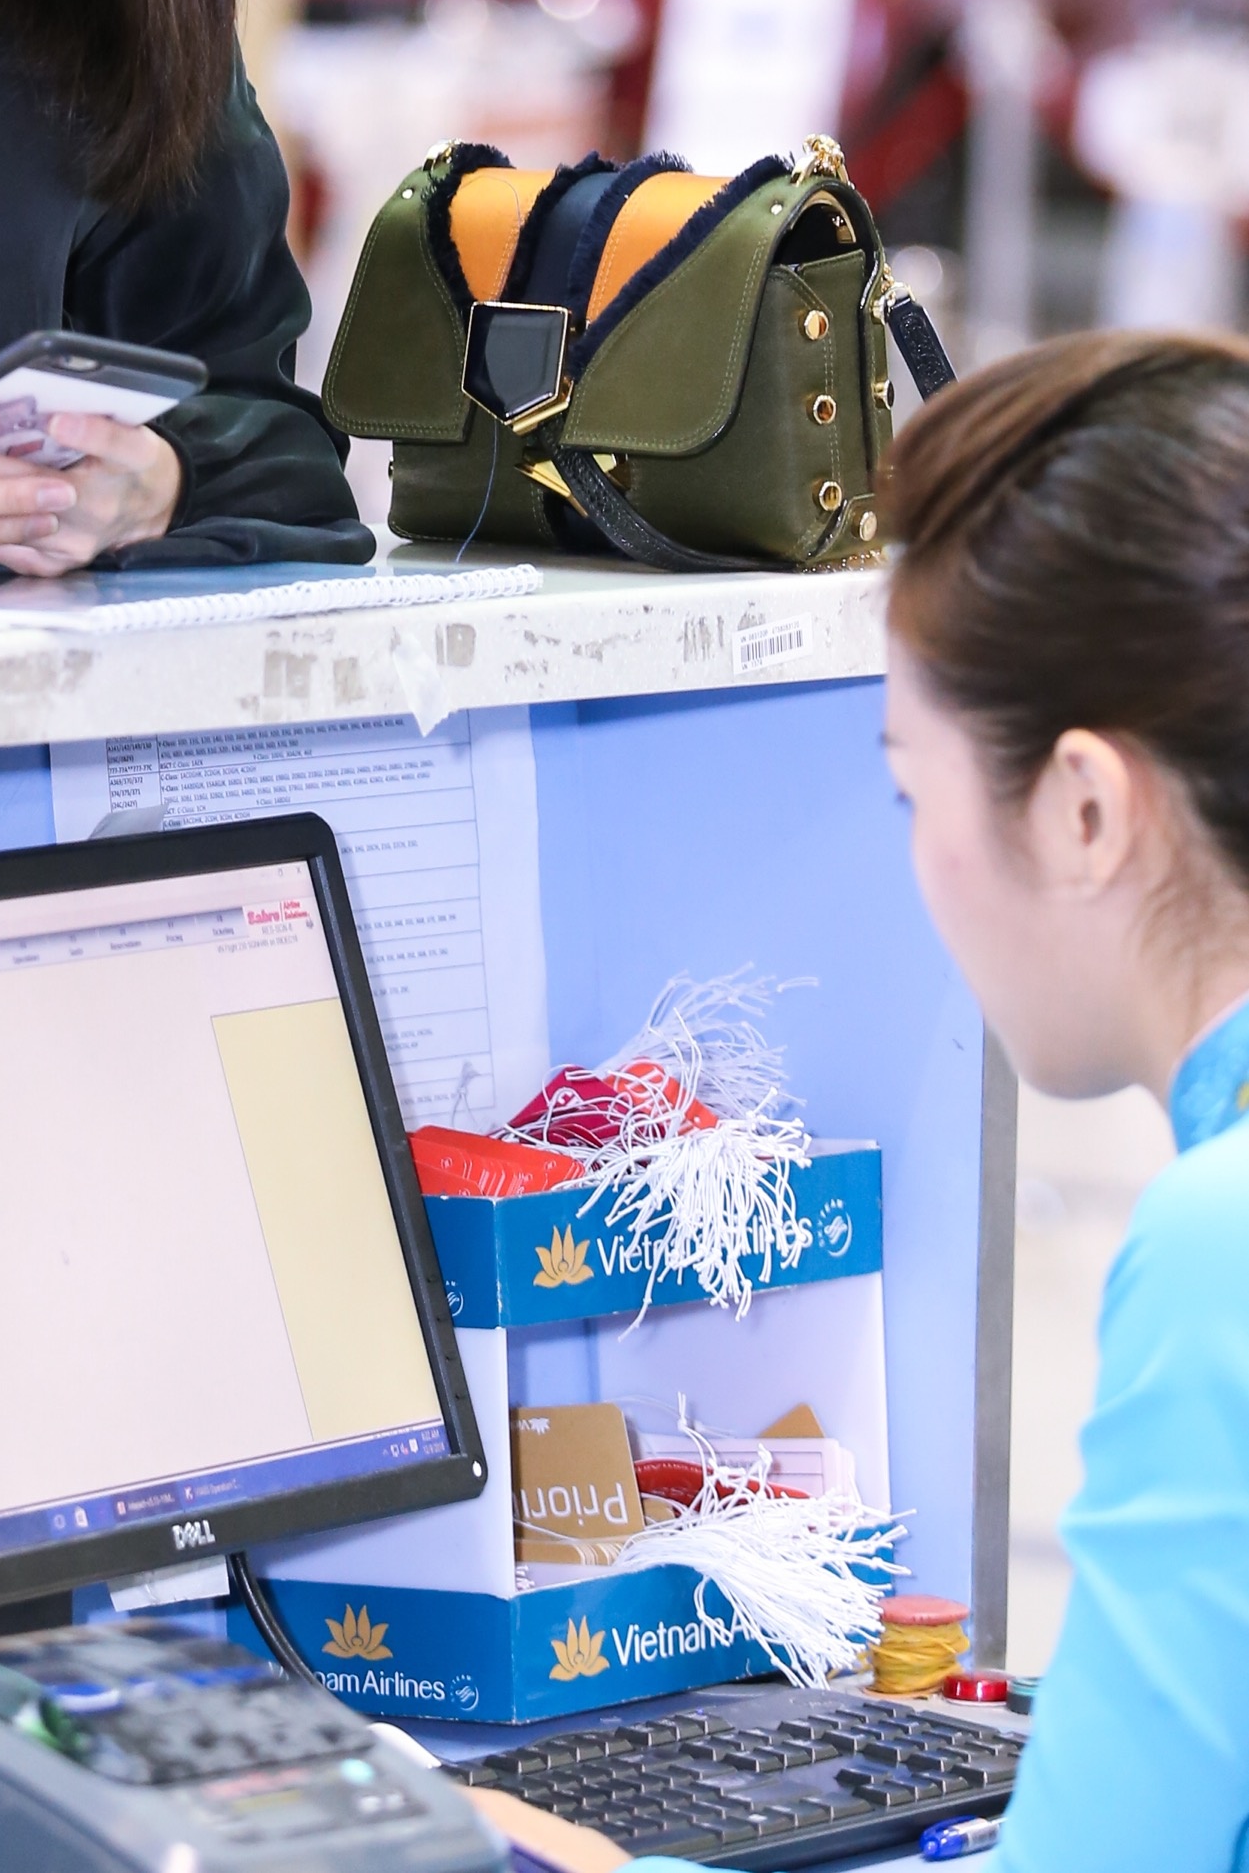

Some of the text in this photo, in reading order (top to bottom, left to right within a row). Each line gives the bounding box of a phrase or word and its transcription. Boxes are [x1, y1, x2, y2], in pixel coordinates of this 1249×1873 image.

[247, 910, 280, 925] Sabre
[521, 1482, 629, 1526] Priori
[172, 1519, 216, 1551] DELL
[362, 1669, 445, 1701] Airlines
